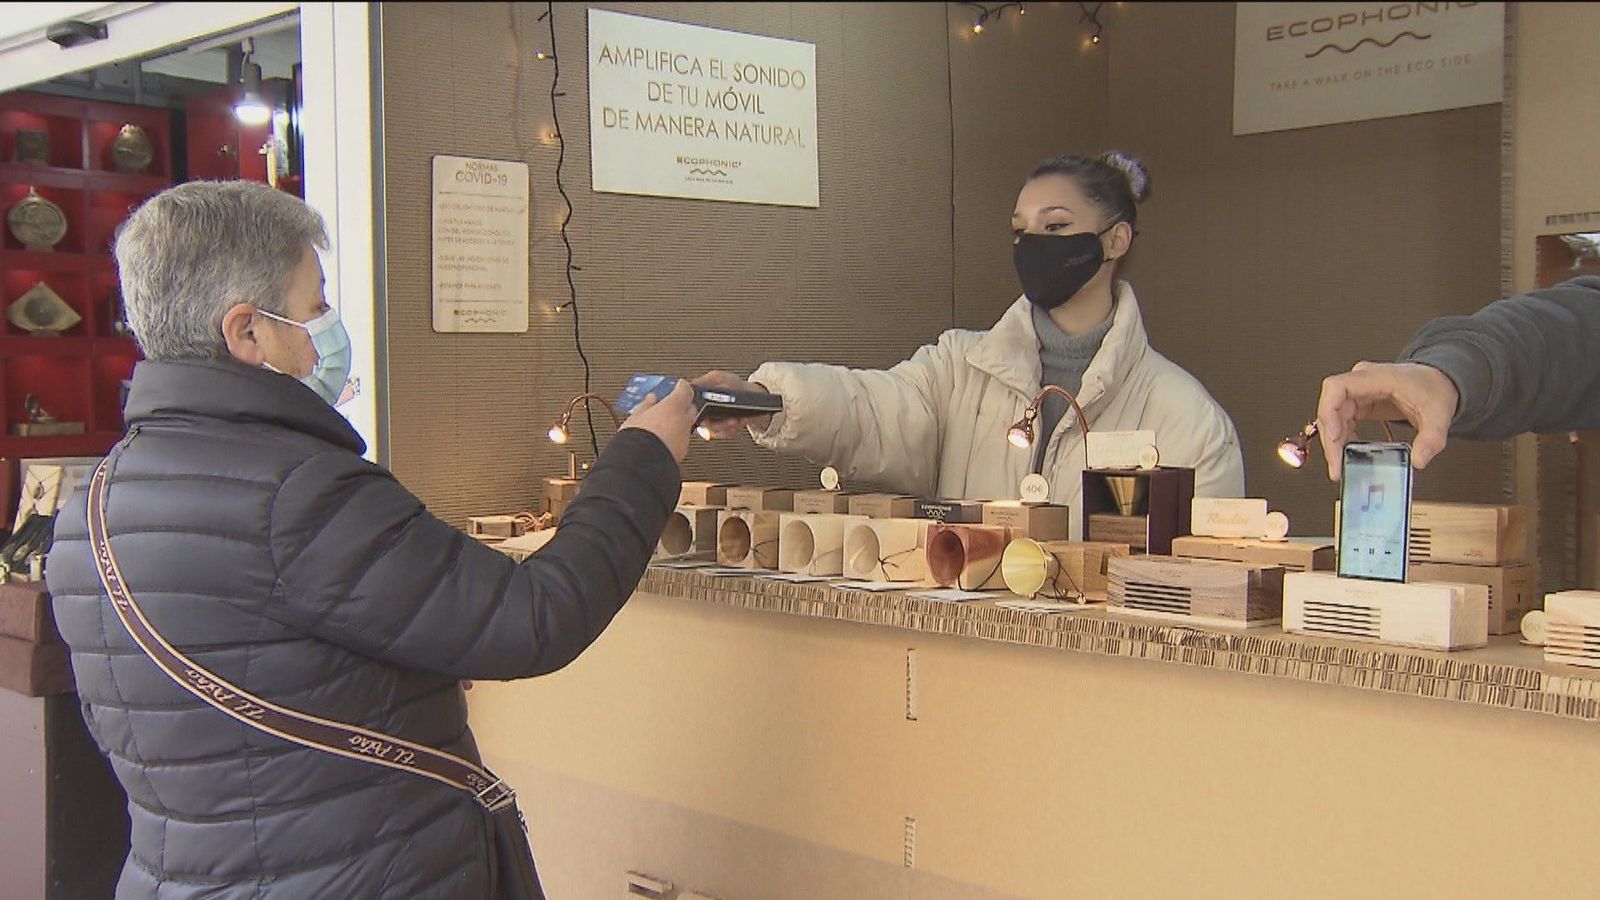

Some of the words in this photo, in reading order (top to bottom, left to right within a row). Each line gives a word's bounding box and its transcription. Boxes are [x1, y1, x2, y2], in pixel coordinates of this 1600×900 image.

[598, 43, 703, 76] AMPLIFICA
[709, 58, 728, 80] EL
[733, 62, 806, 91] SONIDO
[1270, 81, 1298, 92] TAKE
[1303, 79, 1310, 87] A
[1315, 73, 1349, 86] WALK
[1353, 69, 1373, 81] ON
[1377, 64, 1401, 76] THE
[1406, 58, 1435, 73] ECO
[1440, 53, 1472, 68] SIDE
[647, 81, 673, 104] DE
[677, 85, 699, 108] TU
[705, 86, 766, 115] MÓVIL
[602, 107, 629, 130] DE
[635, 111, 720, 140] MANERA
[725, 121, 807, 148] NATURAL
[455, 170, 508, 186] COVID-19
[465, 161, 498, 172] NORMAS
